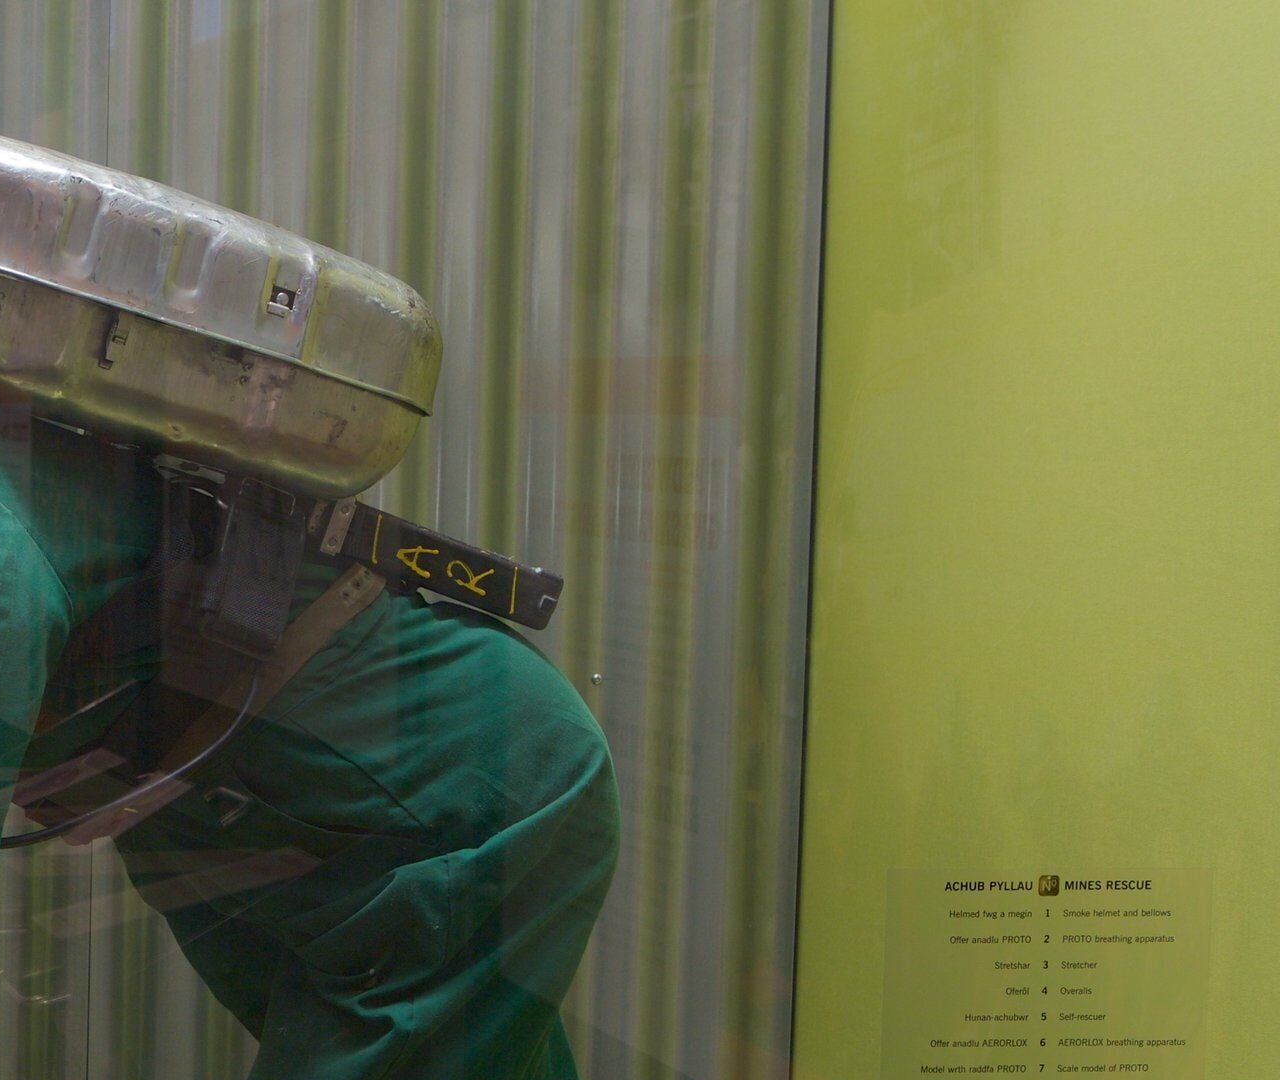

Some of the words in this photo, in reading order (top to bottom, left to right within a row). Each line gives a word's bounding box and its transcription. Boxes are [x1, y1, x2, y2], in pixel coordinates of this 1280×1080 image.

[945, 881, 984, 891] ACHUB
[990, 881, 1033, 891] PYLLAU
[1065, 881, 1101, 890] MINES
[1106, 880, 1151, 890] RESCUE
